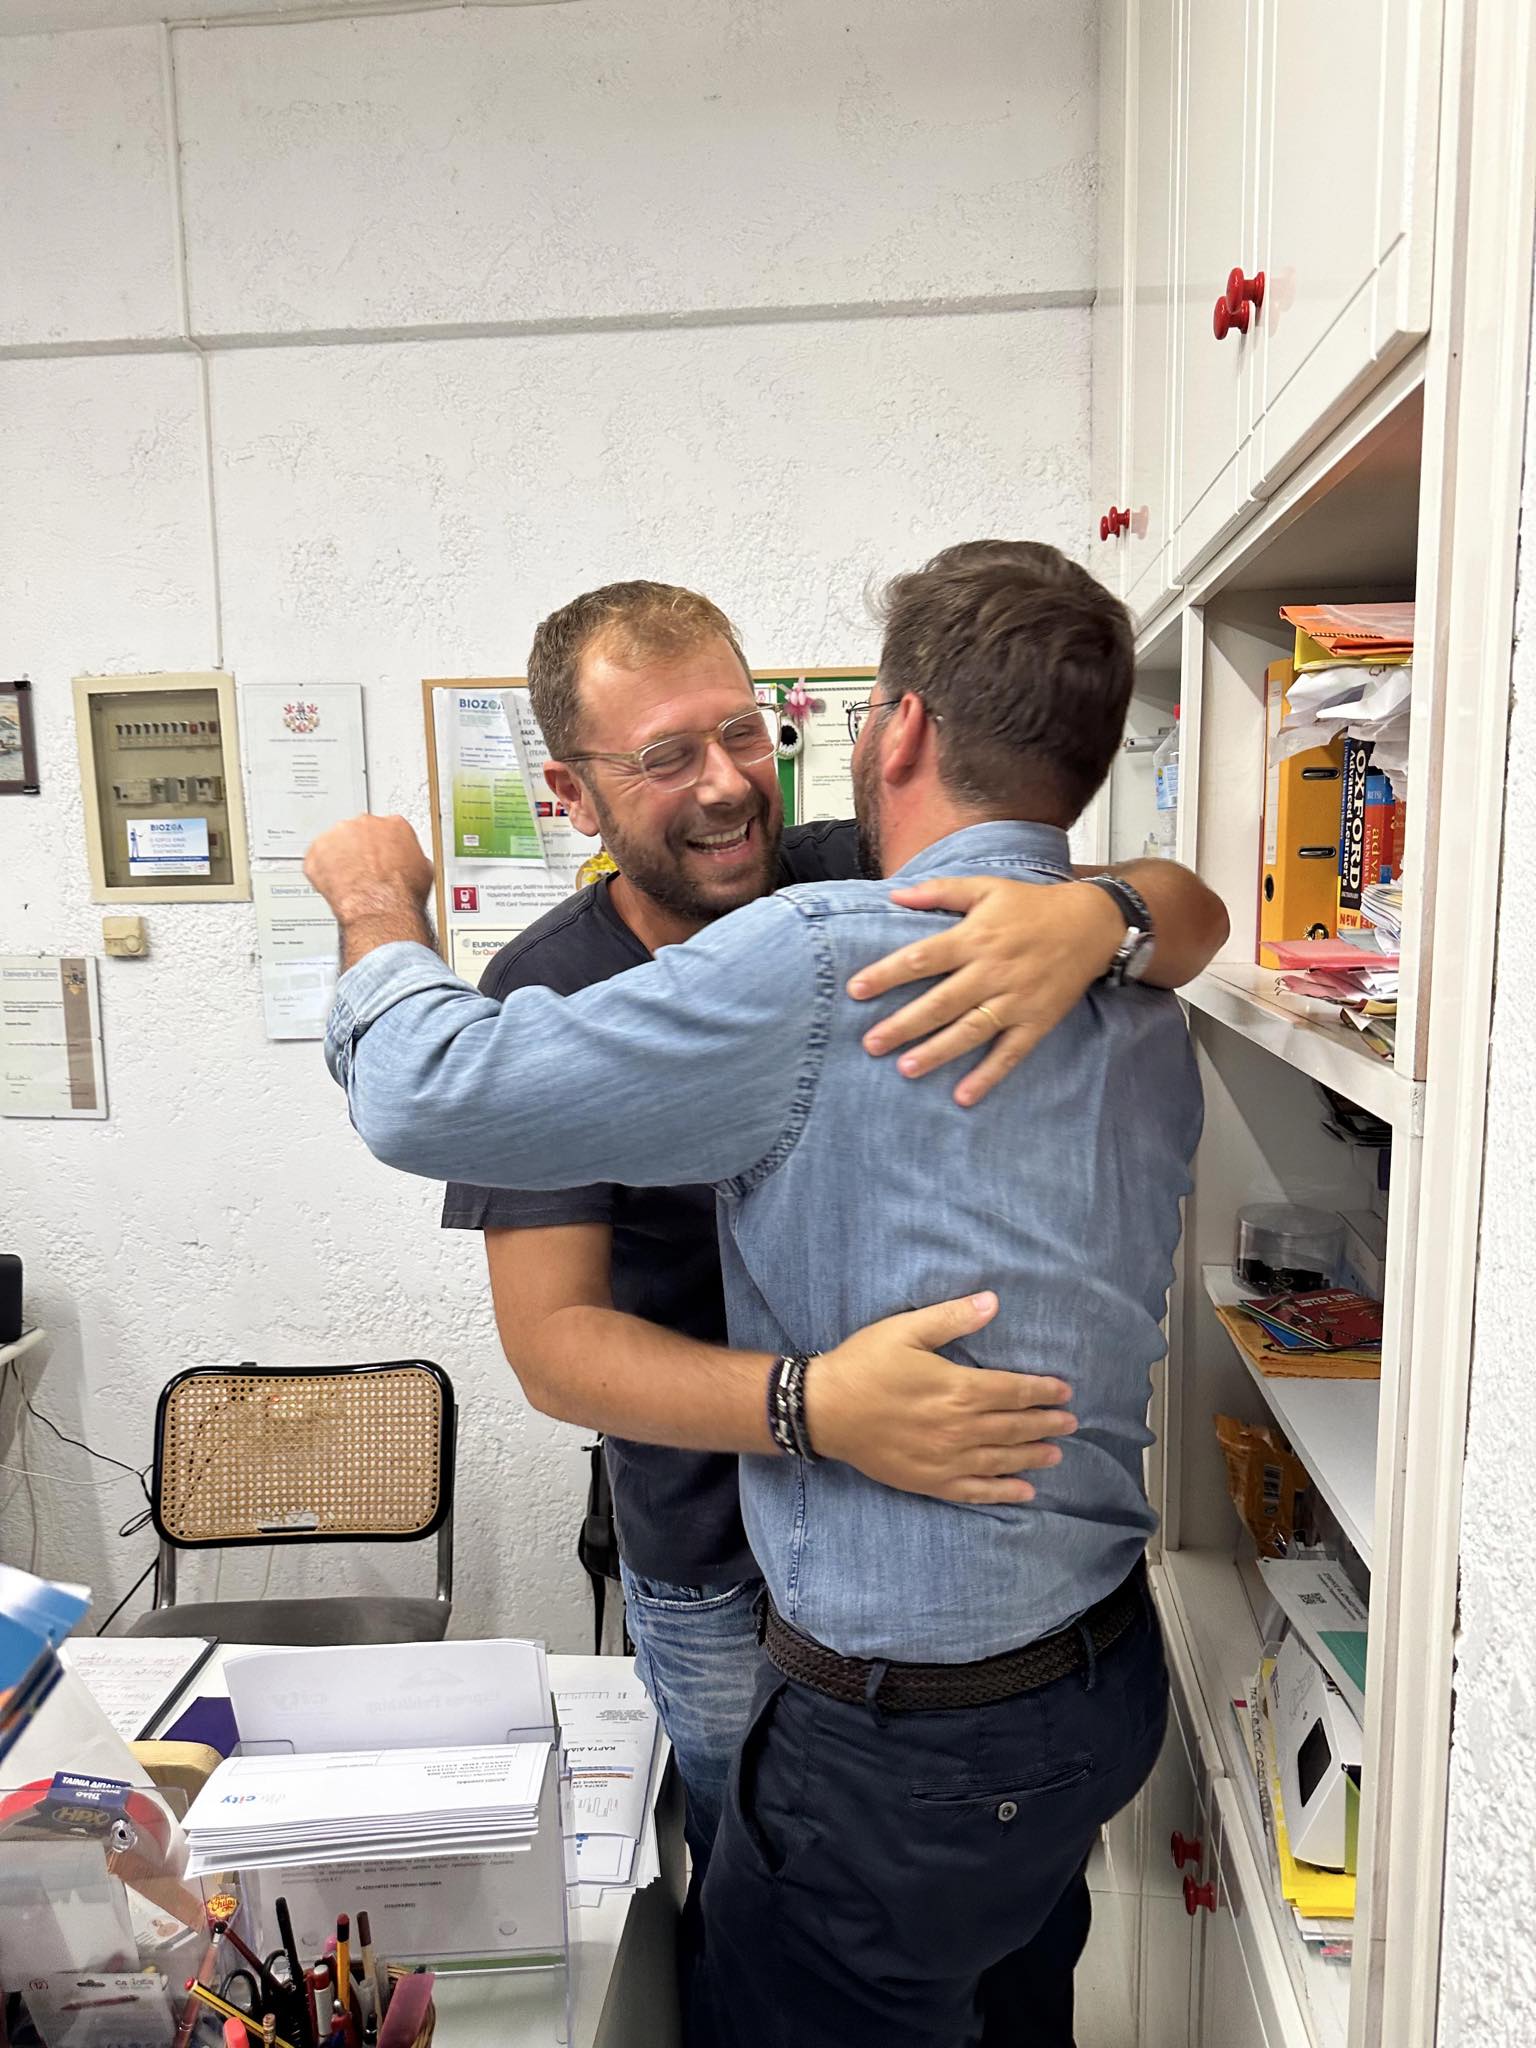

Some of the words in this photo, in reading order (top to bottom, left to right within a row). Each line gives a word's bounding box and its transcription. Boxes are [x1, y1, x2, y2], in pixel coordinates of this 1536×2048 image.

[1346, 750, 1356, 818] Advanced
[1350, 749, 1366, 889] OXFORD
[1342, 821, 1352, 886] Learner's
[1370, 828, 1380, 885] adva
[1340, 914, 1358, 927] NEW
[62, 1776, 90, 1787] ΤΑΙΝΙΑ
[220, 1794, 257, 1804] city
